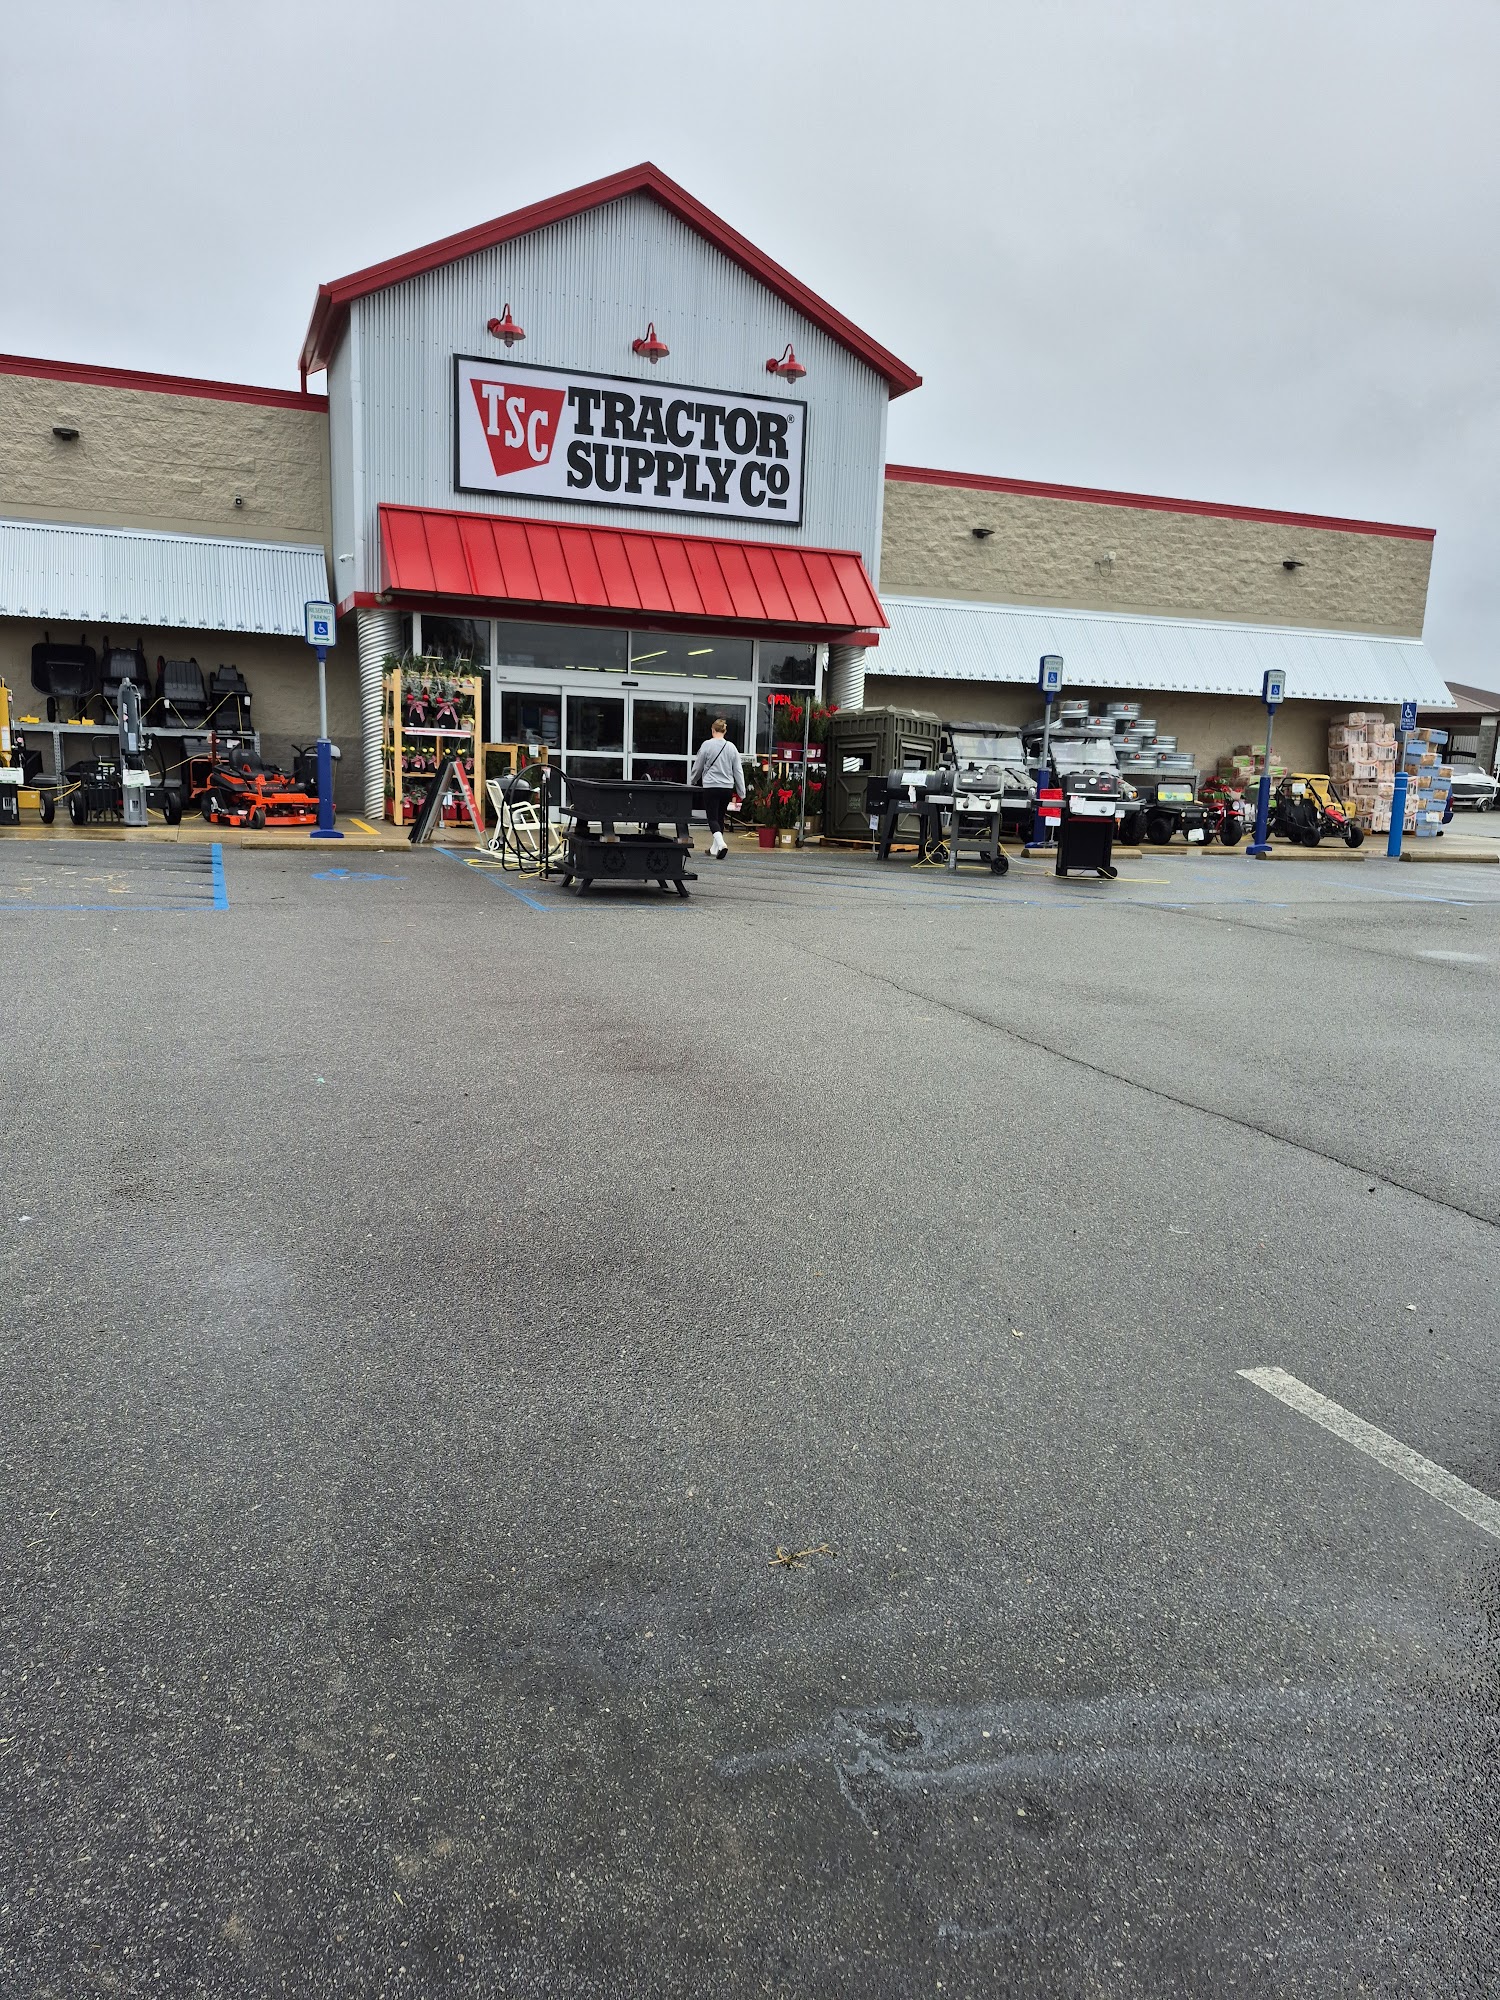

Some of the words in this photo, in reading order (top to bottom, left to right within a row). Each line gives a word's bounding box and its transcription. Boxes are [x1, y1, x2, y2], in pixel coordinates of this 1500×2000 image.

[482, 383, 549, 462] TSC
[567, 440, 737, 504] SUPPLY
[767, 694, 791, 705] OPEN
